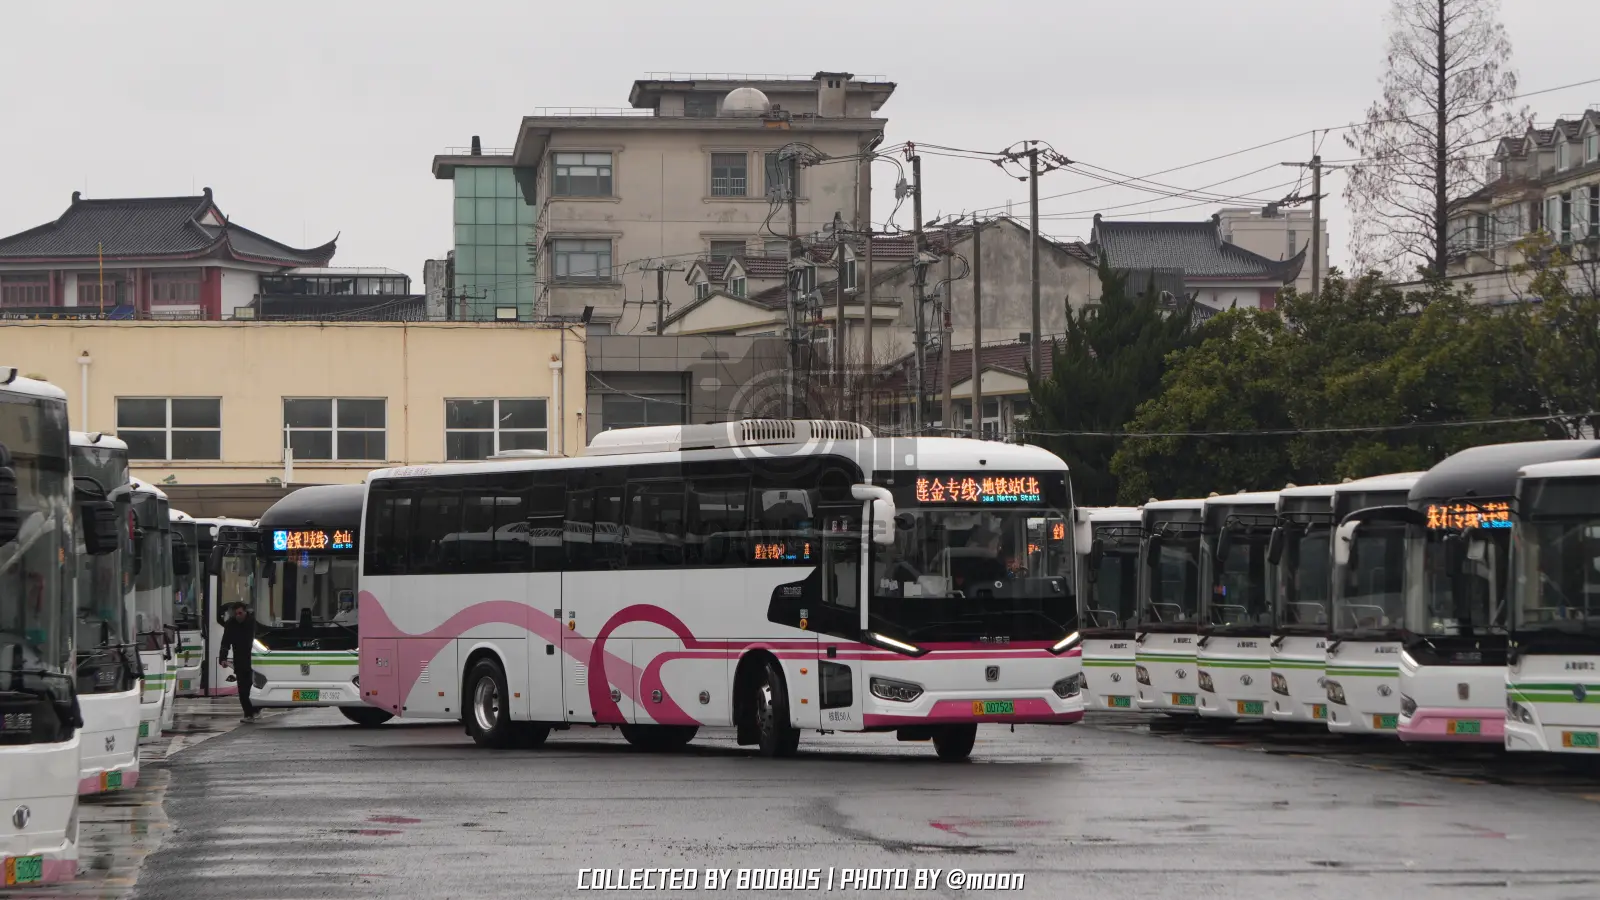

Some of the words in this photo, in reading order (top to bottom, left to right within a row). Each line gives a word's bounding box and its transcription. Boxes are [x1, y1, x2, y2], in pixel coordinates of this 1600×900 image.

[916, 477, 977, 502] 莲金专线
[997, 494, 1018, 502] Metro
